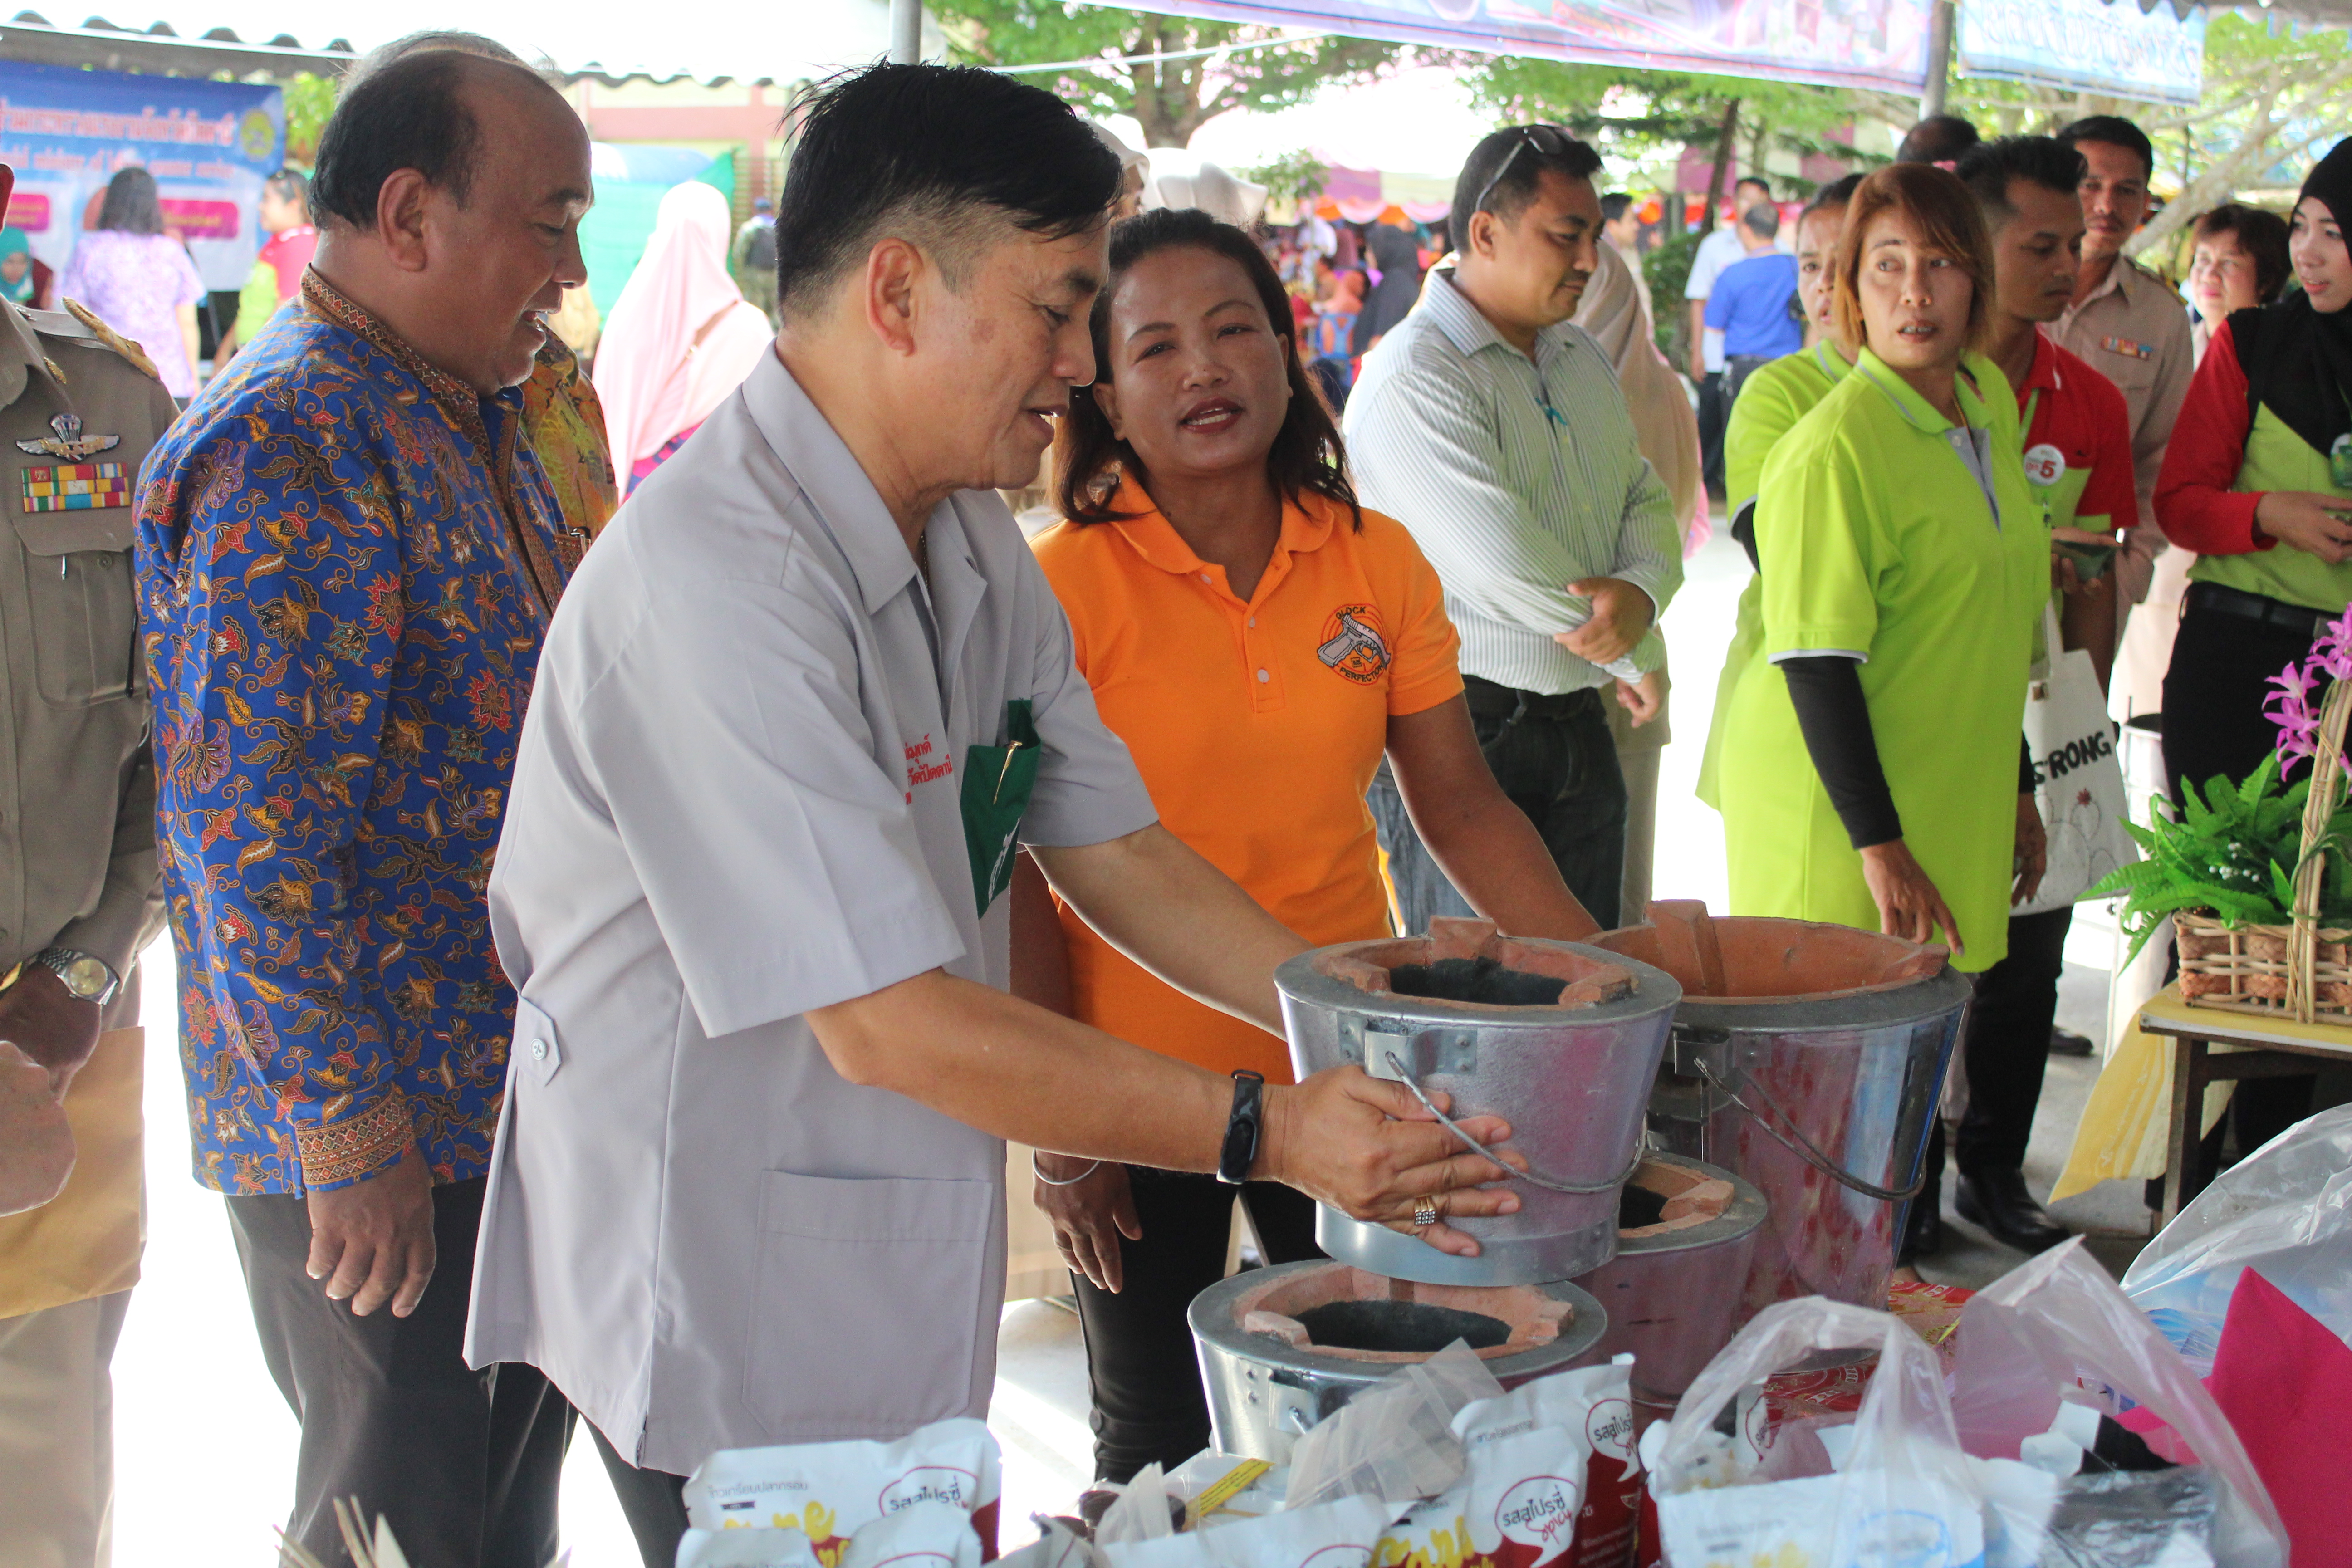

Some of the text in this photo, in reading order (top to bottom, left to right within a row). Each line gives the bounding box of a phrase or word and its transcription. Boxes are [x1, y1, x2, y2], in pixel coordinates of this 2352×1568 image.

[2040, 460, 2056, 479] 5
[1336, 606, 1367, 620] GLOCK
[1339, 664, 1384, 682] PERFECTION
[2033, 731, 2112, 784] SRONG
